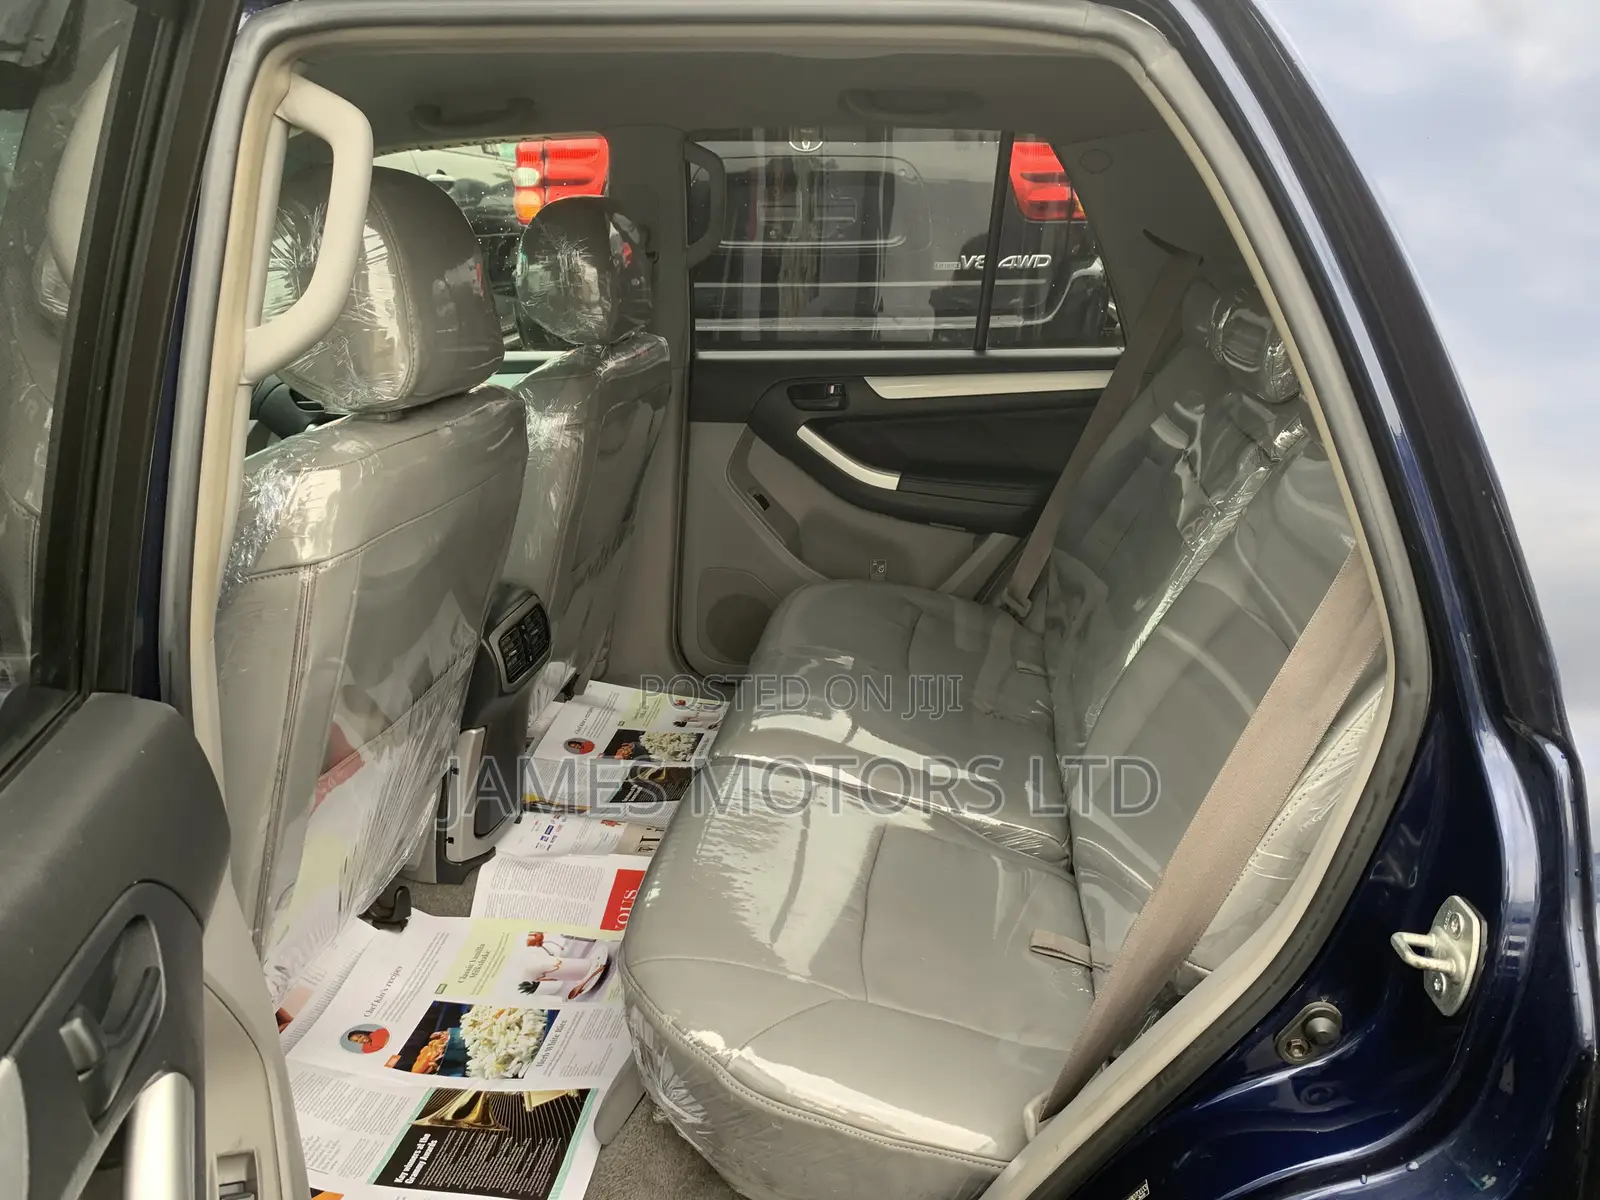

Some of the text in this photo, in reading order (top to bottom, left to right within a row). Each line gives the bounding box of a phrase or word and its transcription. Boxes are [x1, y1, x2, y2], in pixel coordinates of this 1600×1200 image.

[960, 254, 986, 270] V8
[998, 254, 1052, 270] 4WD
[393, 1133, 431, 1183] Key winners at the
[404, 1139, 438, 1184] Grammy Awards
